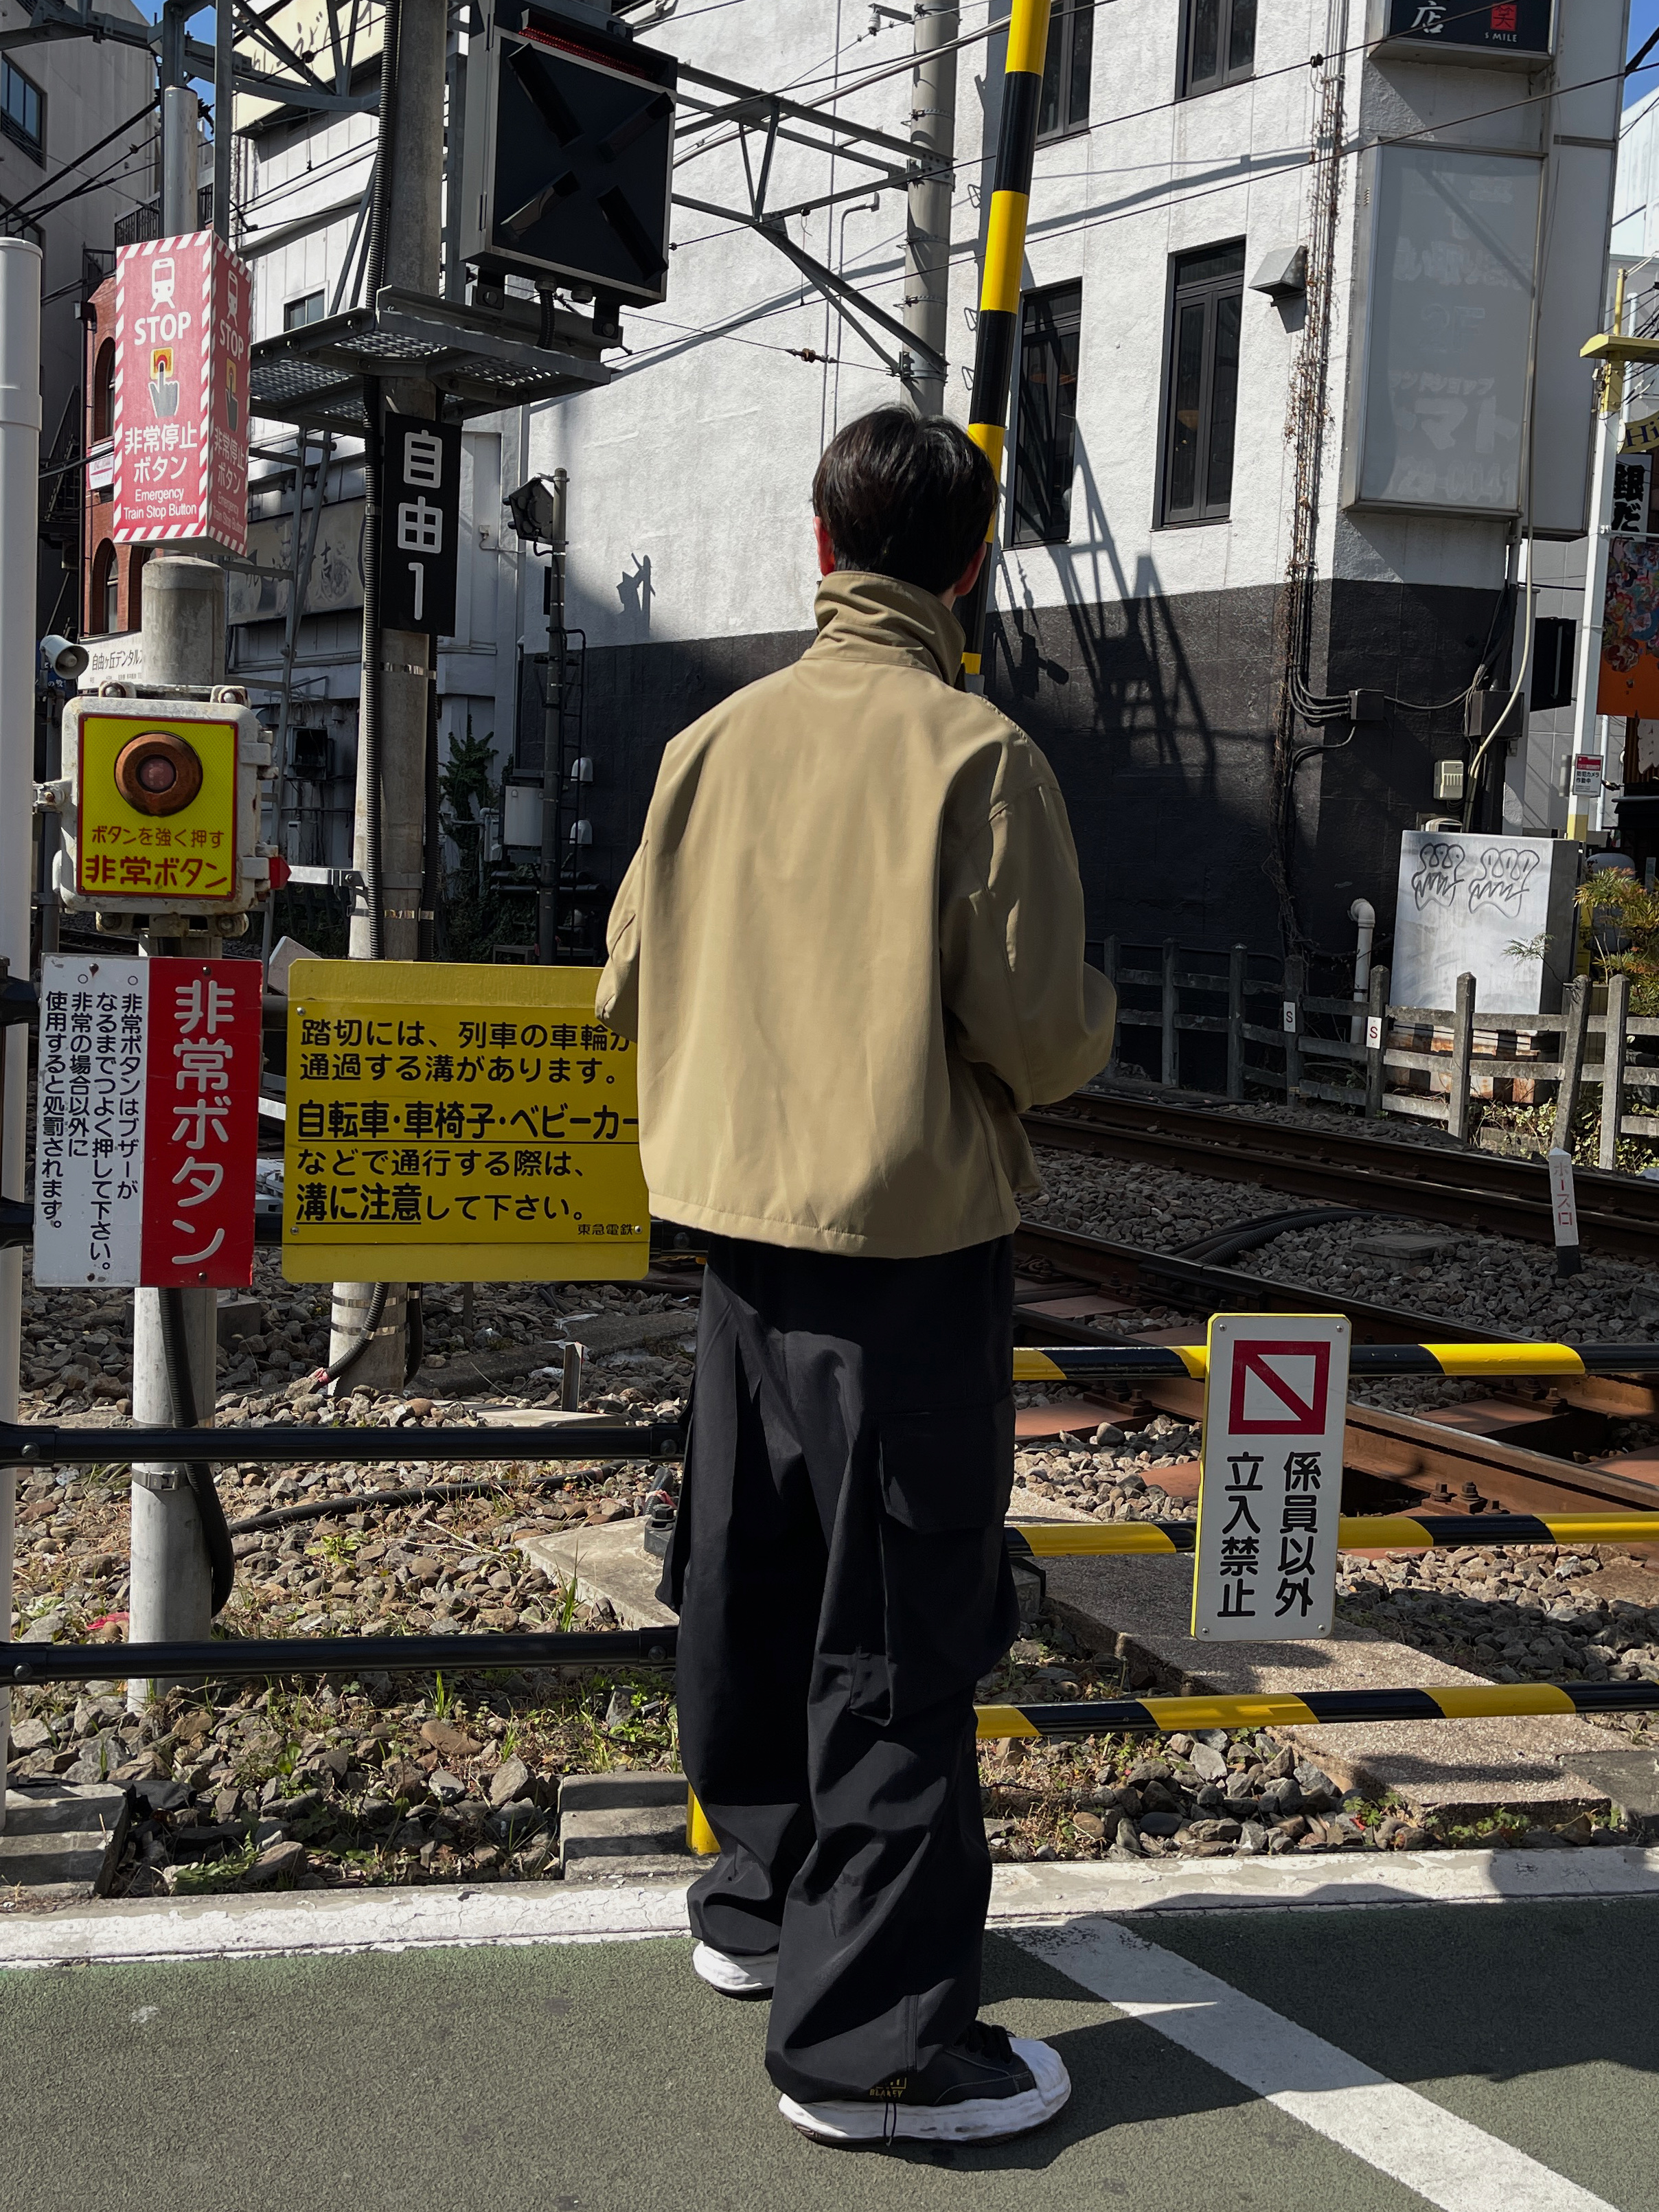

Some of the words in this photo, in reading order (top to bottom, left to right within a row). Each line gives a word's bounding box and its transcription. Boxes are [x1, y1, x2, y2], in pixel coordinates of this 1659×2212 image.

[1410, 0, 1447, 34] 店
[134, 311, 192, 345] STOP
[220, 319, 244, 361] STOP
[124, 420, 198, 455] 非常停止
[214, 425, 245, 472] 非常停止
[1626, 416, 1659, 448] Hi
[133, 456, 187, 483] ボタン
[217, 461, 241, 494] ボタン
[123, 507, 144, 521] Train
[146, 504, 167, 521] Stop
[168, 501, 197, 516] Button
[135, 488, 185, 503] Emergency
[1610, 463, 1645, 541] 銀だ
[92, 825, 225, 848] ボタンを強く押す
[85, 854, 227, 888] 非常ボタン
[1286, 1011, 1293, 1023] S
[1369, 1026, 1378, 1039] S
[69, 992, 93, 1158] 非常の場合以外に
[299, 1053, 616, 1085] 通過する溝があります。
[41, 990, 68, 1229] 使用すると処罰されます。
[117, 993, 143, 1200] 非常ボタンはブザーが
[90, 992, 117, 1271] なるまでつよく押して下さい。
[172, 980, 236, 1265] 非常ボタン
[297, 1148, 584, 1177] などで通行する際は、
[296, 1182, 583, 1222] 溝に注意して下さい。
[577, 1224, 633, 1235] 東急電鉄
[1217, 1451, 1264, 1617] 立入禁止
[1274, 1451, 1322, 1617] 係員以外
